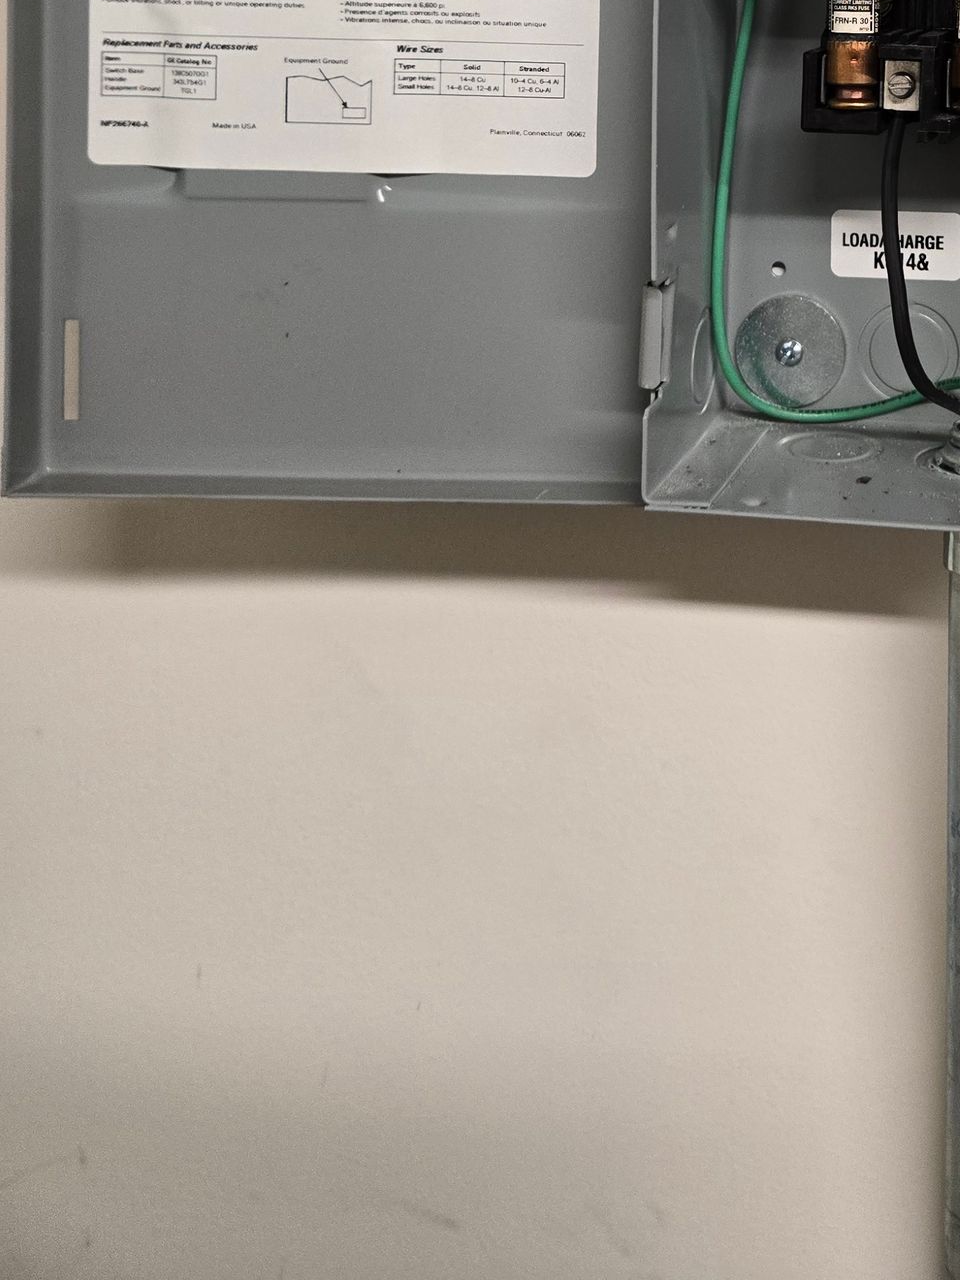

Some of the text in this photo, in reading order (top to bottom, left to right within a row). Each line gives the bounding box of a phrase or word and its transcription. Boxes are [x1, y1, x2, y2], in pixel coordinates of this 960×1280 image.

[103, 38, 258, 51] Replacement Parts and Accessories
[397, 45, 443, 54] Wire Sizes
[523, 129, 563, 137] Connecticut
